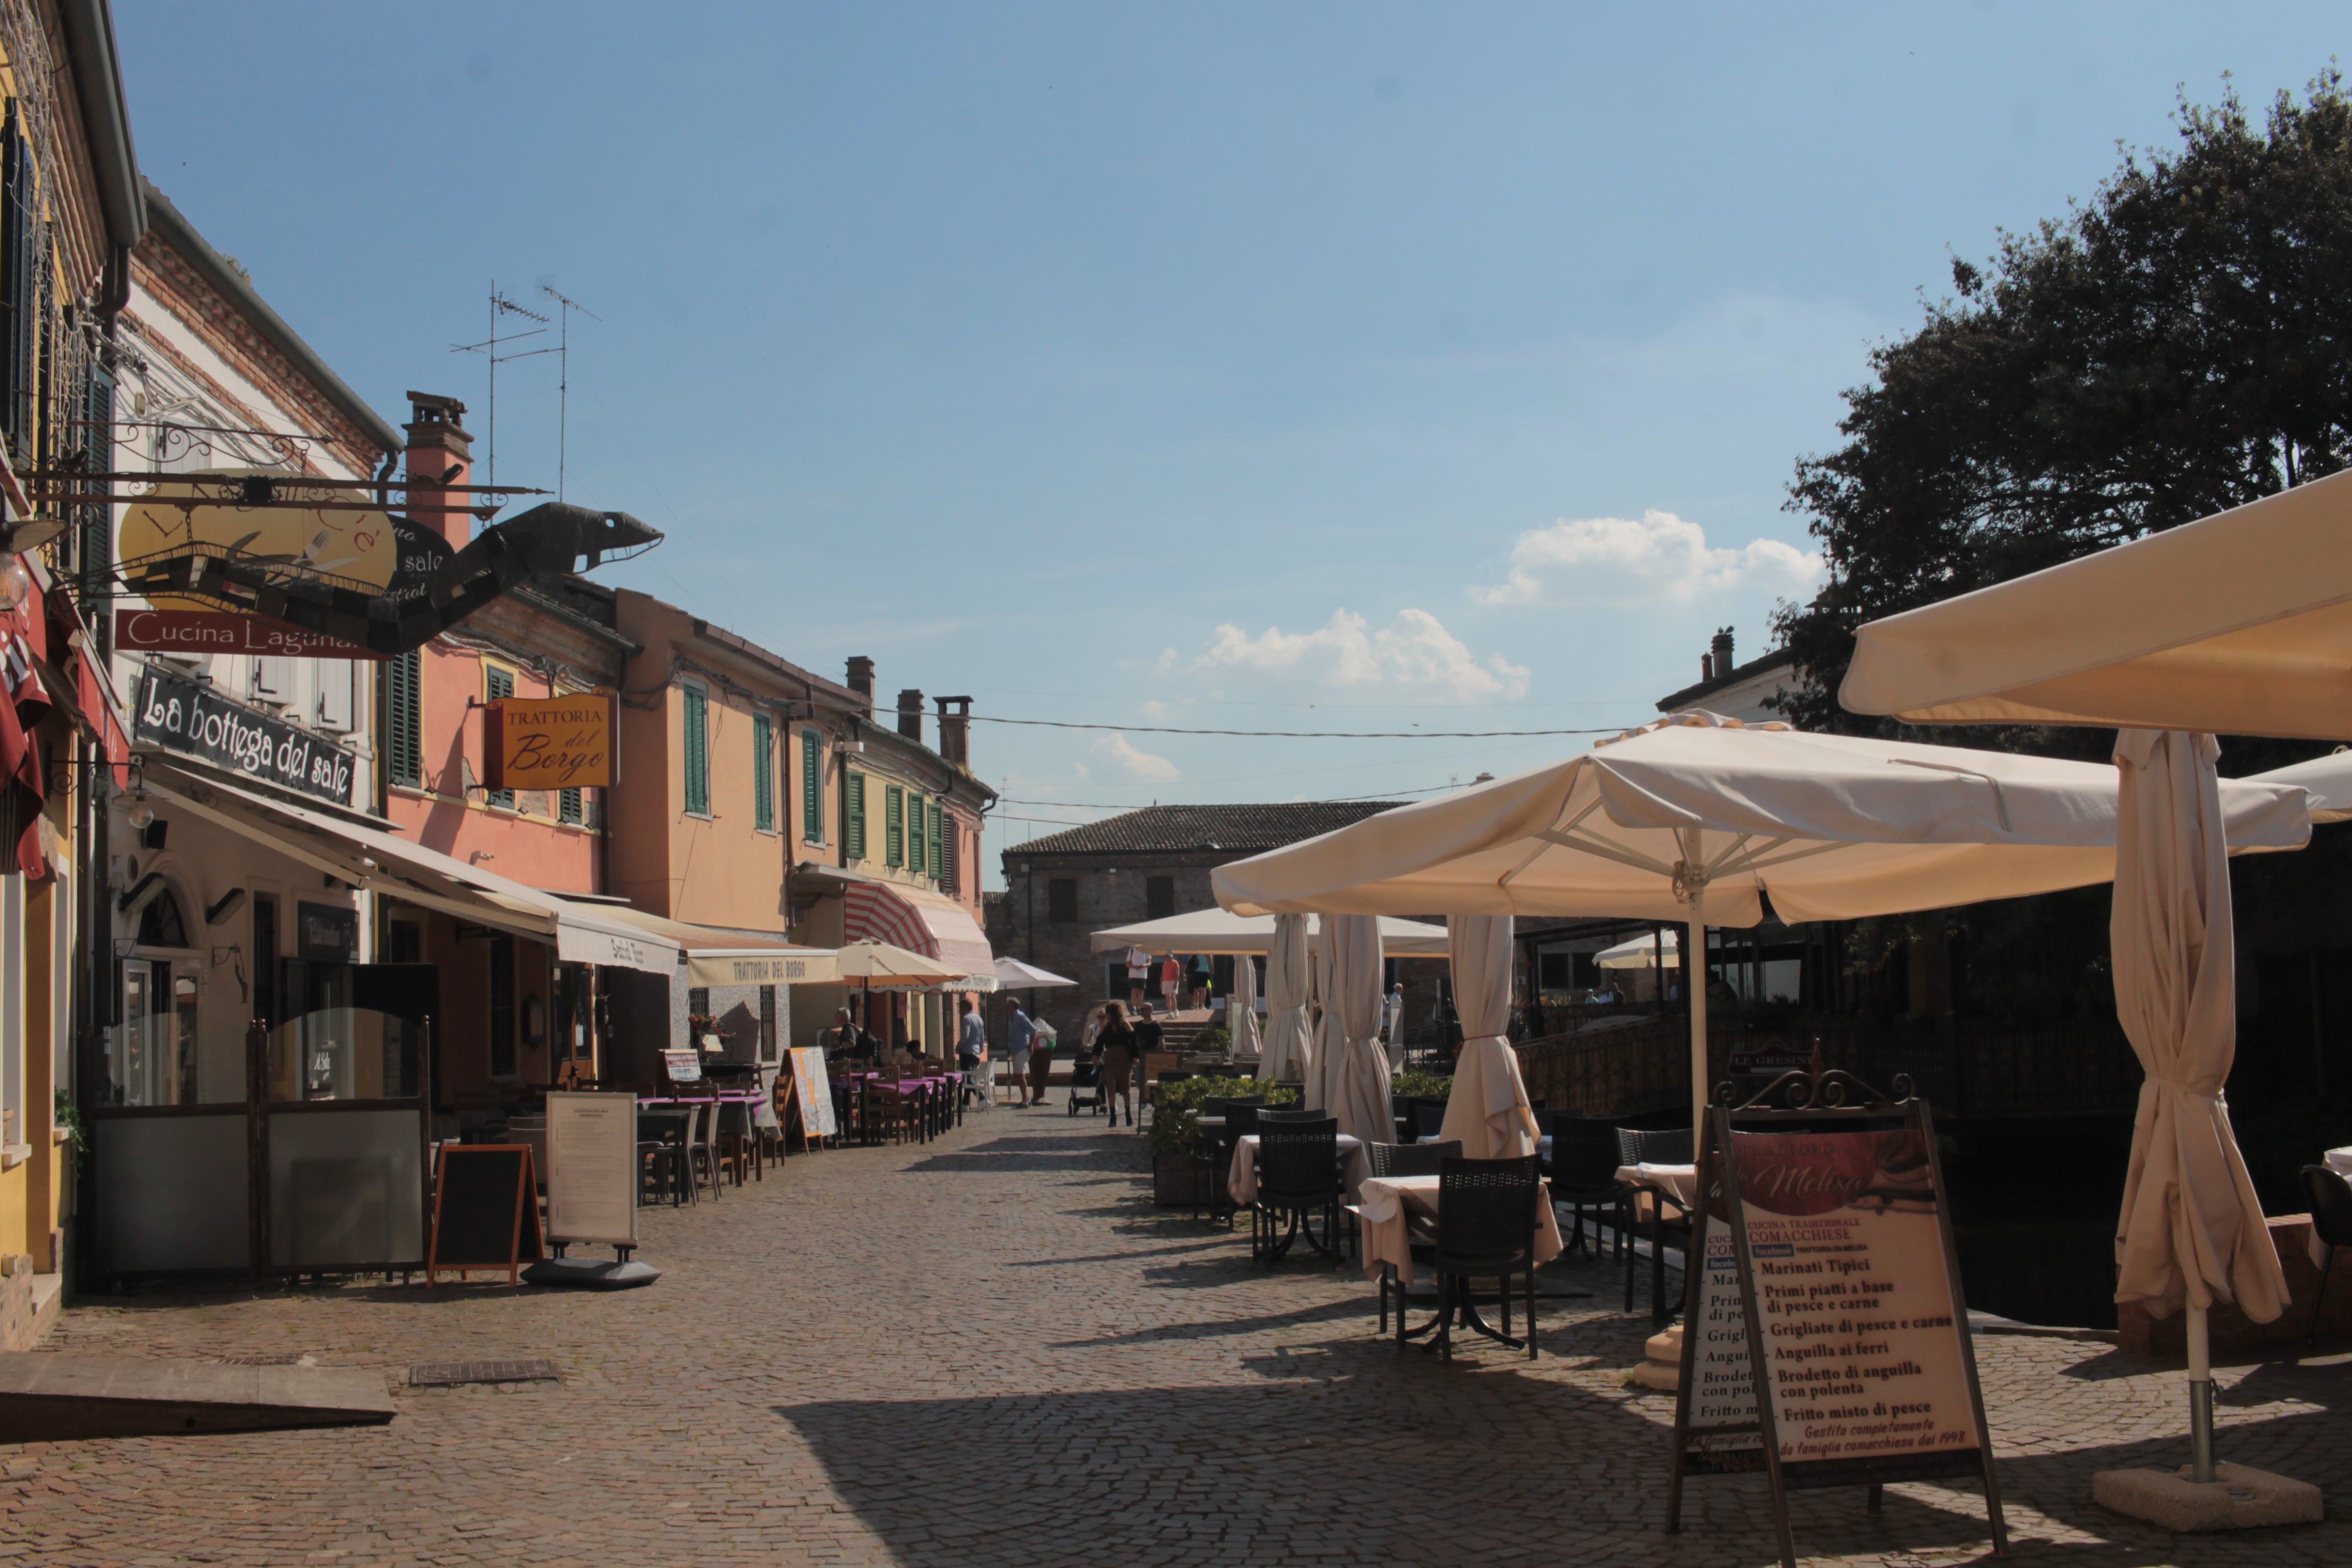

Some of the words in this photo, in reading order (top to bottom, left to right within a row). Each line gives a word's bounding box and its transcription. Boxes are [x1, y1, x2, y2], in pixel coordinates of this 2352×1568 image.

[128, 612, 234, 644] Cucina
[244, 619, 358, 654] Laguna
[507, 710, 602, 725] TRATTORIA
[143, 677, 182, 733] La
[188, 694, 273, 771] bottega
[277, 733, 310, 780] del
[311, 753, 349, 796] sale
[562, 728, 601, 748] del
[507, 733, 604, 783] Borgo
[733, 961, 769, 981] TRATTORIA
[772, 960, 784, 978] DEL
[786, 960, 805, 978] BORGO
[1734, 1056, 1751, 1065] LE
[1740, 1144, 1839, 1156] TRATTORIA
[1754, 1162, 1862, 1200] Melixa
[1747, 1221, 1786, 1230] CUCINA
[1789, 1218, 1861, 1229] TRADIZIONALE
[1708, 1235, 1733, 1244] CUCI
[1749, 1228, 1852, 1243] COMACCHIESE
[1755, 1245, 1792, 1256] facebook
[1795, 1245, 1832, 1254] TRATTORIA
[1711, 1259, 1736, 1268] faceb
[1761, 1261, 1823, 1275] Marinati
[1826, 1258, 1871, 1276] Tipici
[1764, 1284, 1805, 1298] Primi
[1809, 1282, 1846, 1300] piatti
[1850, 1284, 1859, 1294] a
[1861, 1280, 1894, 1294] base
[1711, 1294, 1742, 1307] Prim
[1767, 1299, 1782, 1313] di
[1785, 1300, 1824, 1316] pesce
[1828, 1301, 1836, 1310] e
[1840, 1298, 1880, 1310] carne
[1709, 1308, 1723, 1321] di
[1708, 1327, 1745, 1344] Grigl
[1770, 1321, 1834, 1340] Grigliate
[1839, 1319, 1853, 1333] di
[1856, 1319, 1897, 1336] pesce
[1901, 1320, 1908, 1329] e
[1912, 1315, 1953, 1328] carne
[1706, 1349, 1749, 1365] Angui
[1774, 1344, 1835, 1363] Anguilla
[1839, 1343, 1852, 1356] ai
[1855, 1341, 1890, 1355] ferri
[1703, 1369, 1754, 1384] Brodet
[1778, 1366, 1841, 1383] Brodetto
[1844, 1365, 1859, 1379] di
[1863, 1361, 1922, 1381] anguilla
[1702, 1387, 1728, 1397] con
[1780, 1389, 1806, 1398] con
[1810, 1381, 1864, 1401] polenta
[1701, 1405, 1741, 1418] Fritto
[1783, 1407, 1825, 1422] Fritto
[1829, 1404, 1869, 1419] misto
[1872, 1402, 1887, 1417] di
[1891, 1402, 1931, 1419] pesce
[1805, 1423, 1847, 1439] Gestita
[1850, 1418, 1935, 1438] completamente
[1780, 1442, 1793, 1456] da
[1797, 1441, 1841, 1458] famiglia
[1844, 1435, 1914, 1452] comacchiese
[1918, 1433, 1935, 1447] dal
[1939, 1430, 1966, 1445] 1998
